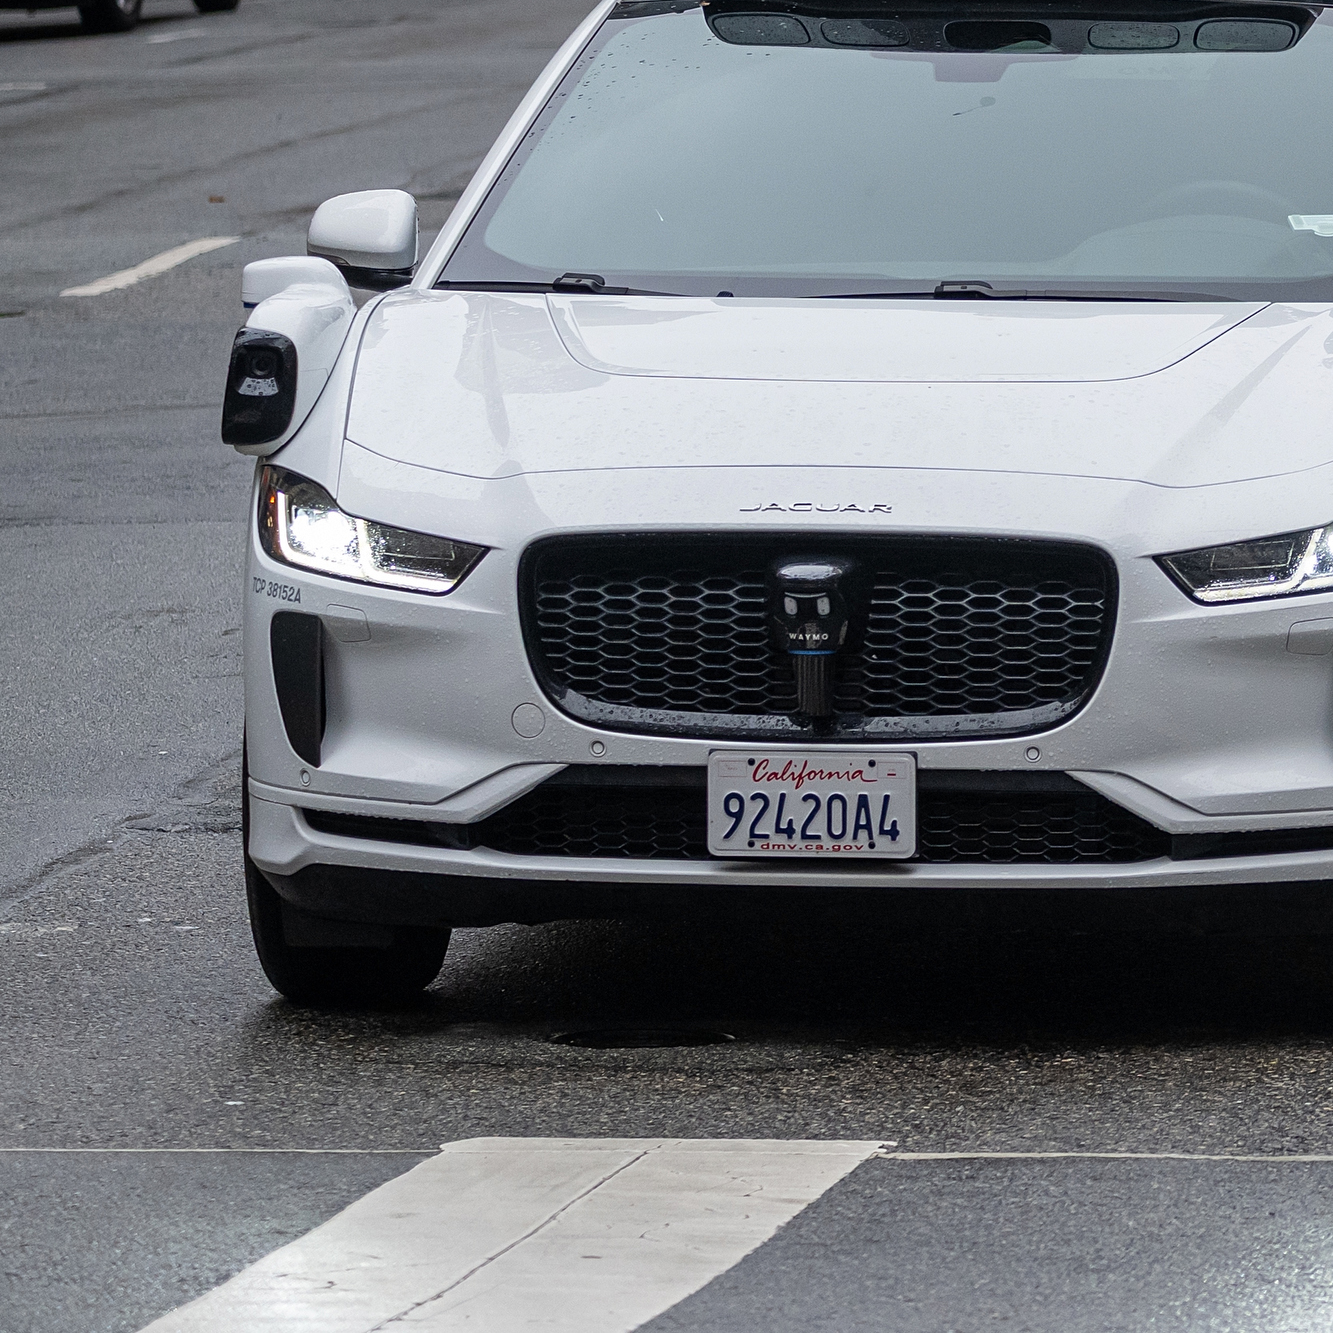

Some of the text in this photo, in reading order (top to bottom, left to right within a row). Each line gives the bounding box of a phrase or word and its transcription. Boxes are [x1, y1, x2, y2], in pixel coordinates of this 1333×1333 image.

[740, 502, 893, 514] JAGUAR
[252, 576, 301, 604] TCP 38152A
[788, 632, 829, 641] WAYMO
[752, 758, 878, 790] California
[722, 791, 900, 842] 92420A4
[760, 841, 865, 852] dmv.ca.gov
